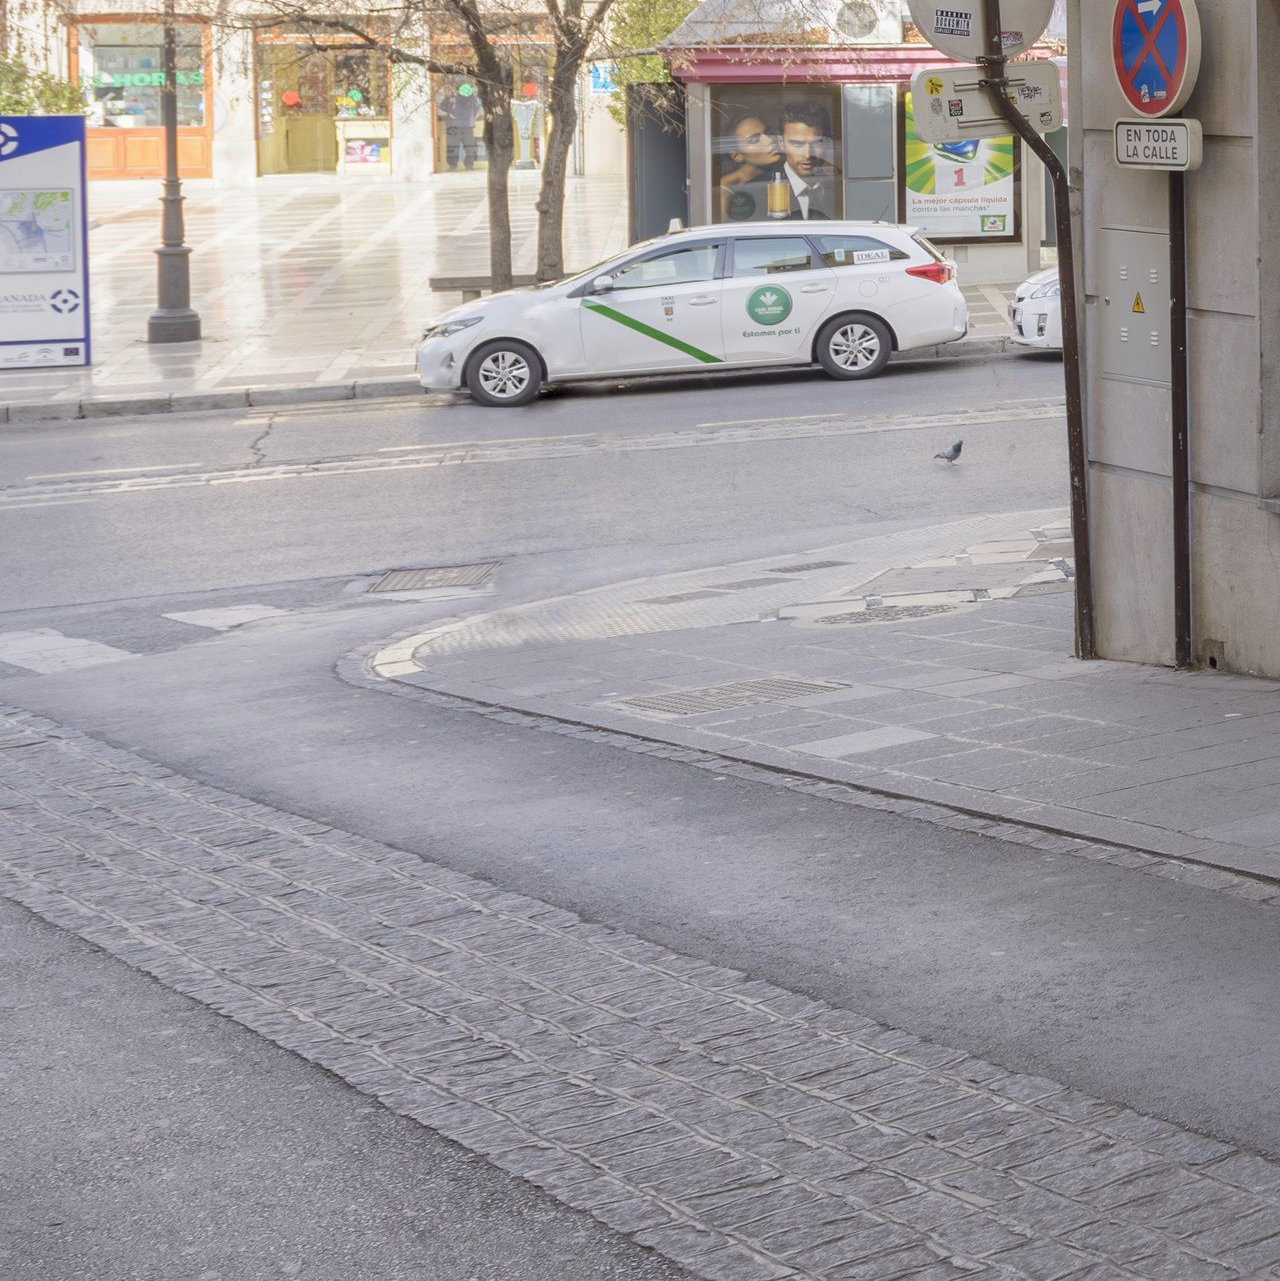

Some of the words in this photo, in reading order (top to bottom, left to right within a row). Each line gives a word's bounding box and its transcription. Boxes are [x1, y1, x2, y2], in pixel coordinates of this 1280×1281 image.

[1126, 129, 1141, 142] EN
[1146, 129, 1176, 143] TODA
[1126, 145, 1139, 158] LA
[1143, 146, 1178, 160] CALLE
[953, 168, 966, 187] 1
[924, 197, 947, 206] mejor
[949, 196, 979, 206] cápsula
[857, 251, 887, 260] IDEAL
[778, 329, 792, 337] por
